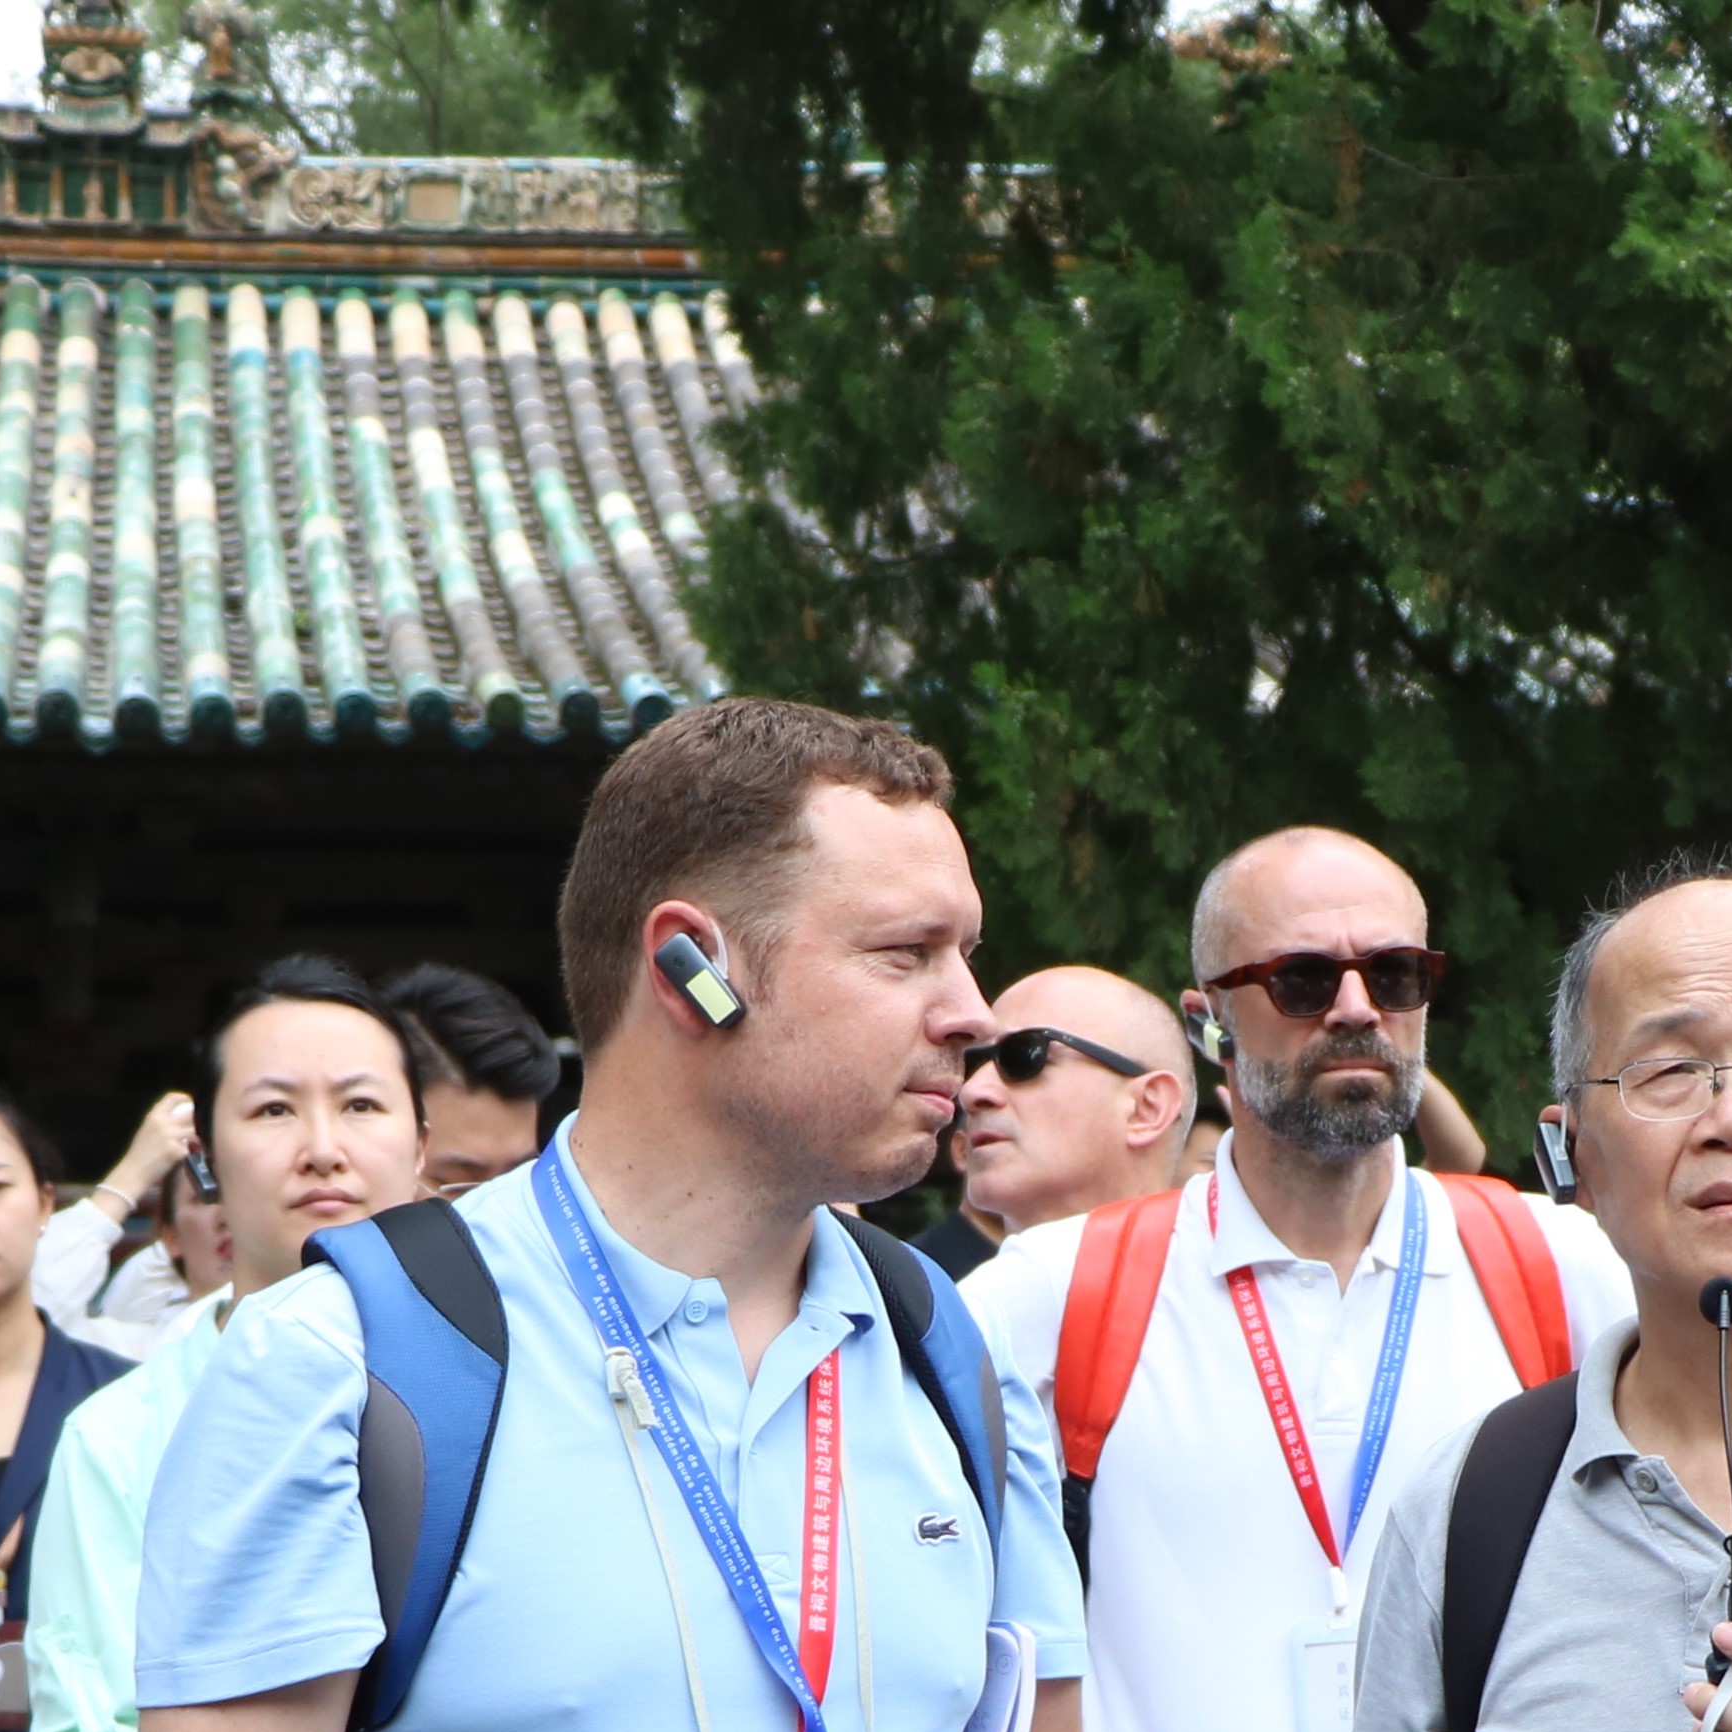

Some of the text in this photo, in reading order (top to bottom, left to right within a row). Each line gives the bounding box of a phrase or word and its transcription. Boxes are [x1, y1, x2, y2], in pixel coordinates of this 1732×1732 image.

[547, 1164, 574, 1219] Protection
[570, 1221, 599, 1271] intégrée
[596, 1273, 612, 1294] des
[608, 1296, 642, 1357] monuments
[641, 1358, 681, 1433] historiques
[676, 1434, 692, 1450] et
[685, 1451, 702, 1469] de
[697, 1471, 751, 1572] l'environnement
[747, 1574, 775, 1622] naturel
[769, 1625, 784, 1642] du
[778, 1643, 799, 1673] Site
[793, 1674, 806, 1690] de
[593, 1295, 621, 1341] Atelier
[693, 1490, 745, 1587] franco-chinois
[809, 1354, 836, 1632] 晋祠文物建筑与周边环境系统保
